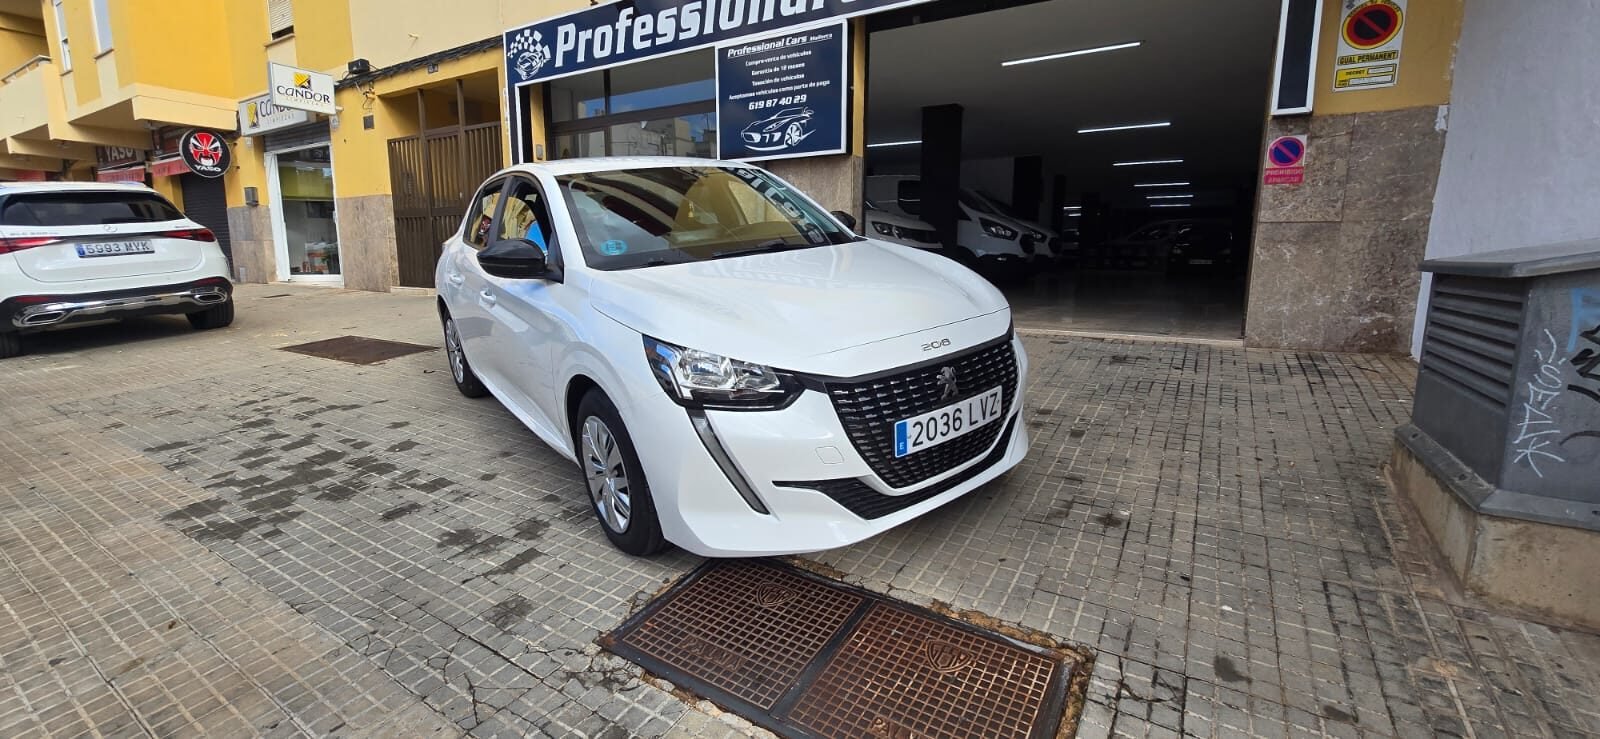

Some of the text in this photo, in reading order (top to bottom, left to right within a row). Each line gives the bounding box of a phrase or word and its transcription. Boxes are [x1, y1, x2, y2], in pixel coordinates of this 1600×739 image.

[554, 0, 824, 68] Profession
[727, 38, 785, 58] Professional
[785, 35, 807, 46] Cars
[1358, 51, 1397, 63] PERMANENT
[748, 93, 808, 111] 619 87 40 29
[194, 164, 222, 173] YASO
[85, 239, 150, 255] 5993 MVK
[921, 338, 951, 352] 208
[912, 391, 999, 448] 2036 LVZ
